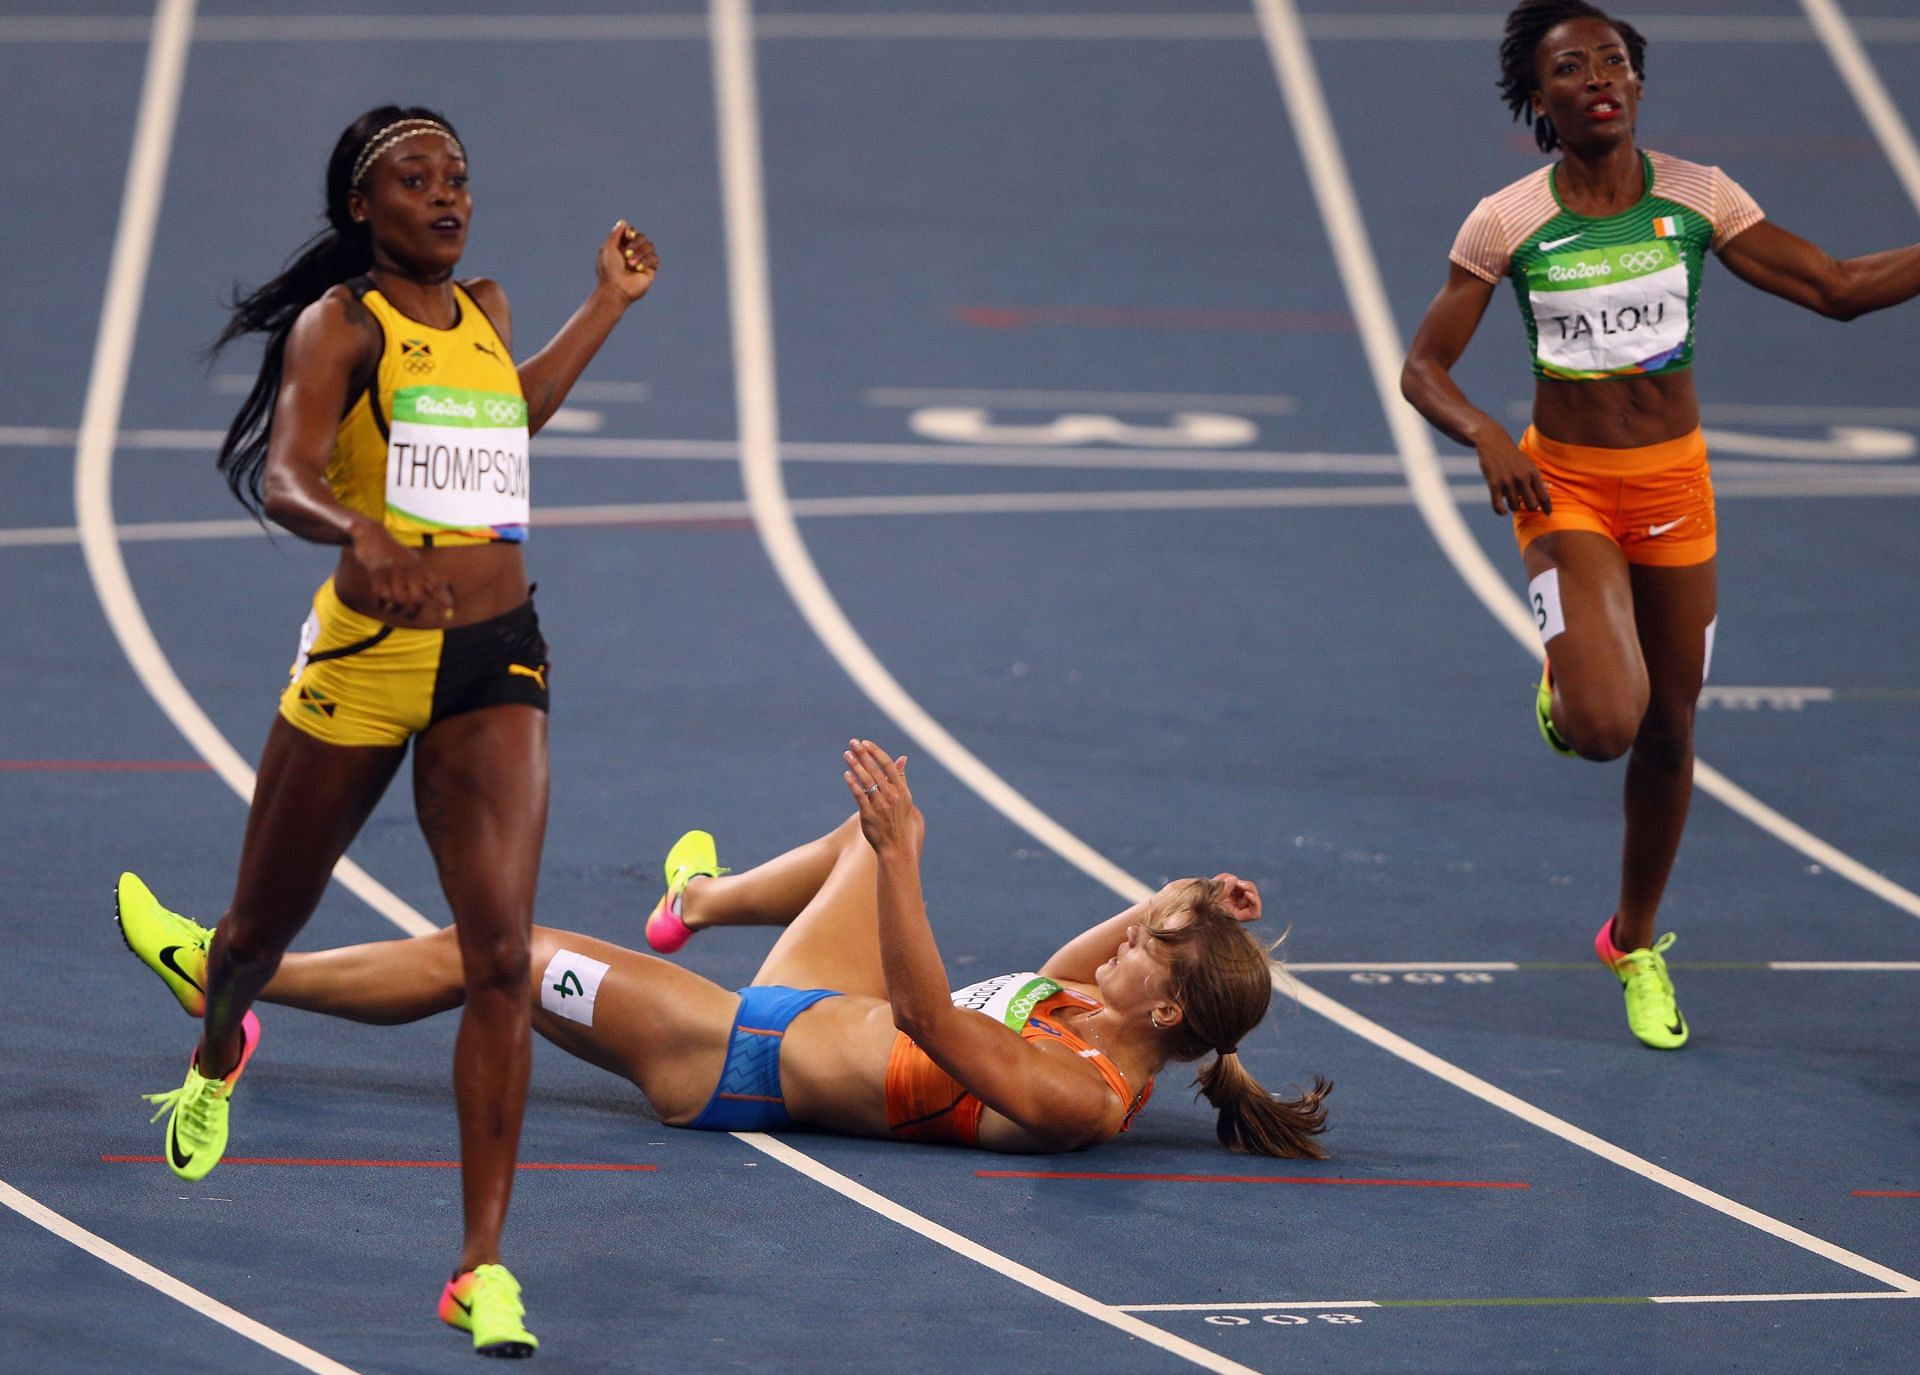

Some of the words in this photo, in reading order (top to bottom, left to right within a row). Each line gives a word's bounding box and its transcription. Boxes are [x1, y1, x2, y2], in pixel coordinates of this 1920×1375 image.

[1548, 259, 1612, 282] Rio2016
[1552, 314, 1593, 340] TA
[1601, 302, 1664, 335] LOU
[393, 442, 527, 500] THOMPSON
[1534, 592, 1547, 632] 3
[553, 969, 584, 999] 4
